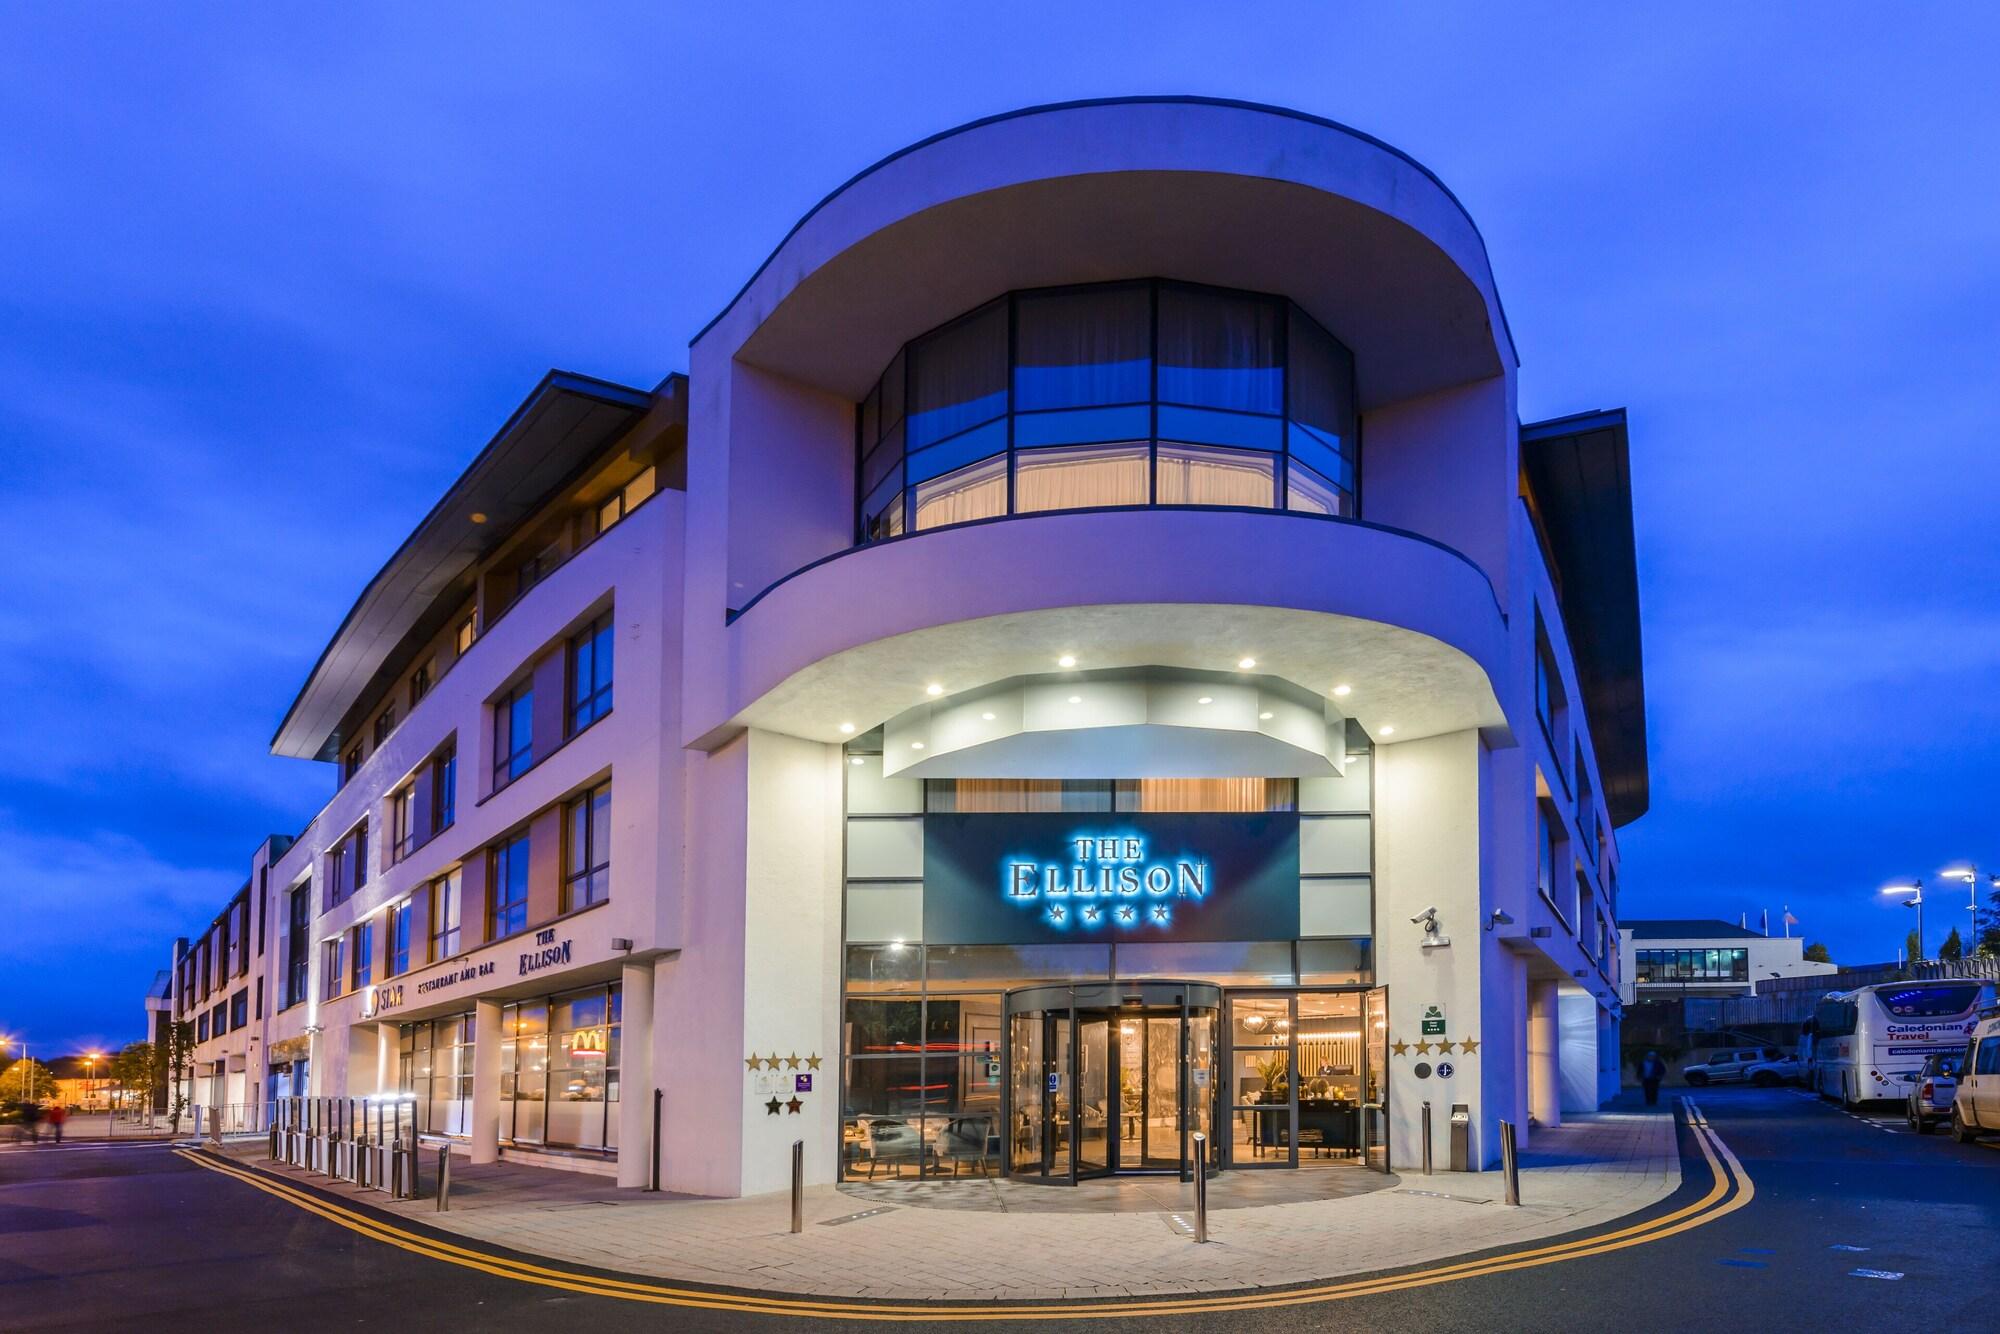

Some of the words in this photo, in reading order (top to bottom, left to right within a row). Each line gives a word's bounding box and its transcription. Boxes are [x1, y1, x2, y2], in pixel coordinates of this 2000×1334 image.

[1075, 838, 1142, 860] THE
[1008, 863, 1207, 897] ELLISON
[536, 927, 556, 946] THE
[519, 940, 573, 976] ELLISON
[459, 969, 476, 983] AND
[478, 961, 495, 976] BAR
[1887, 1024, 1963, 1033] Caledonian
[1888, 1032, 1930, 1040] Travel
